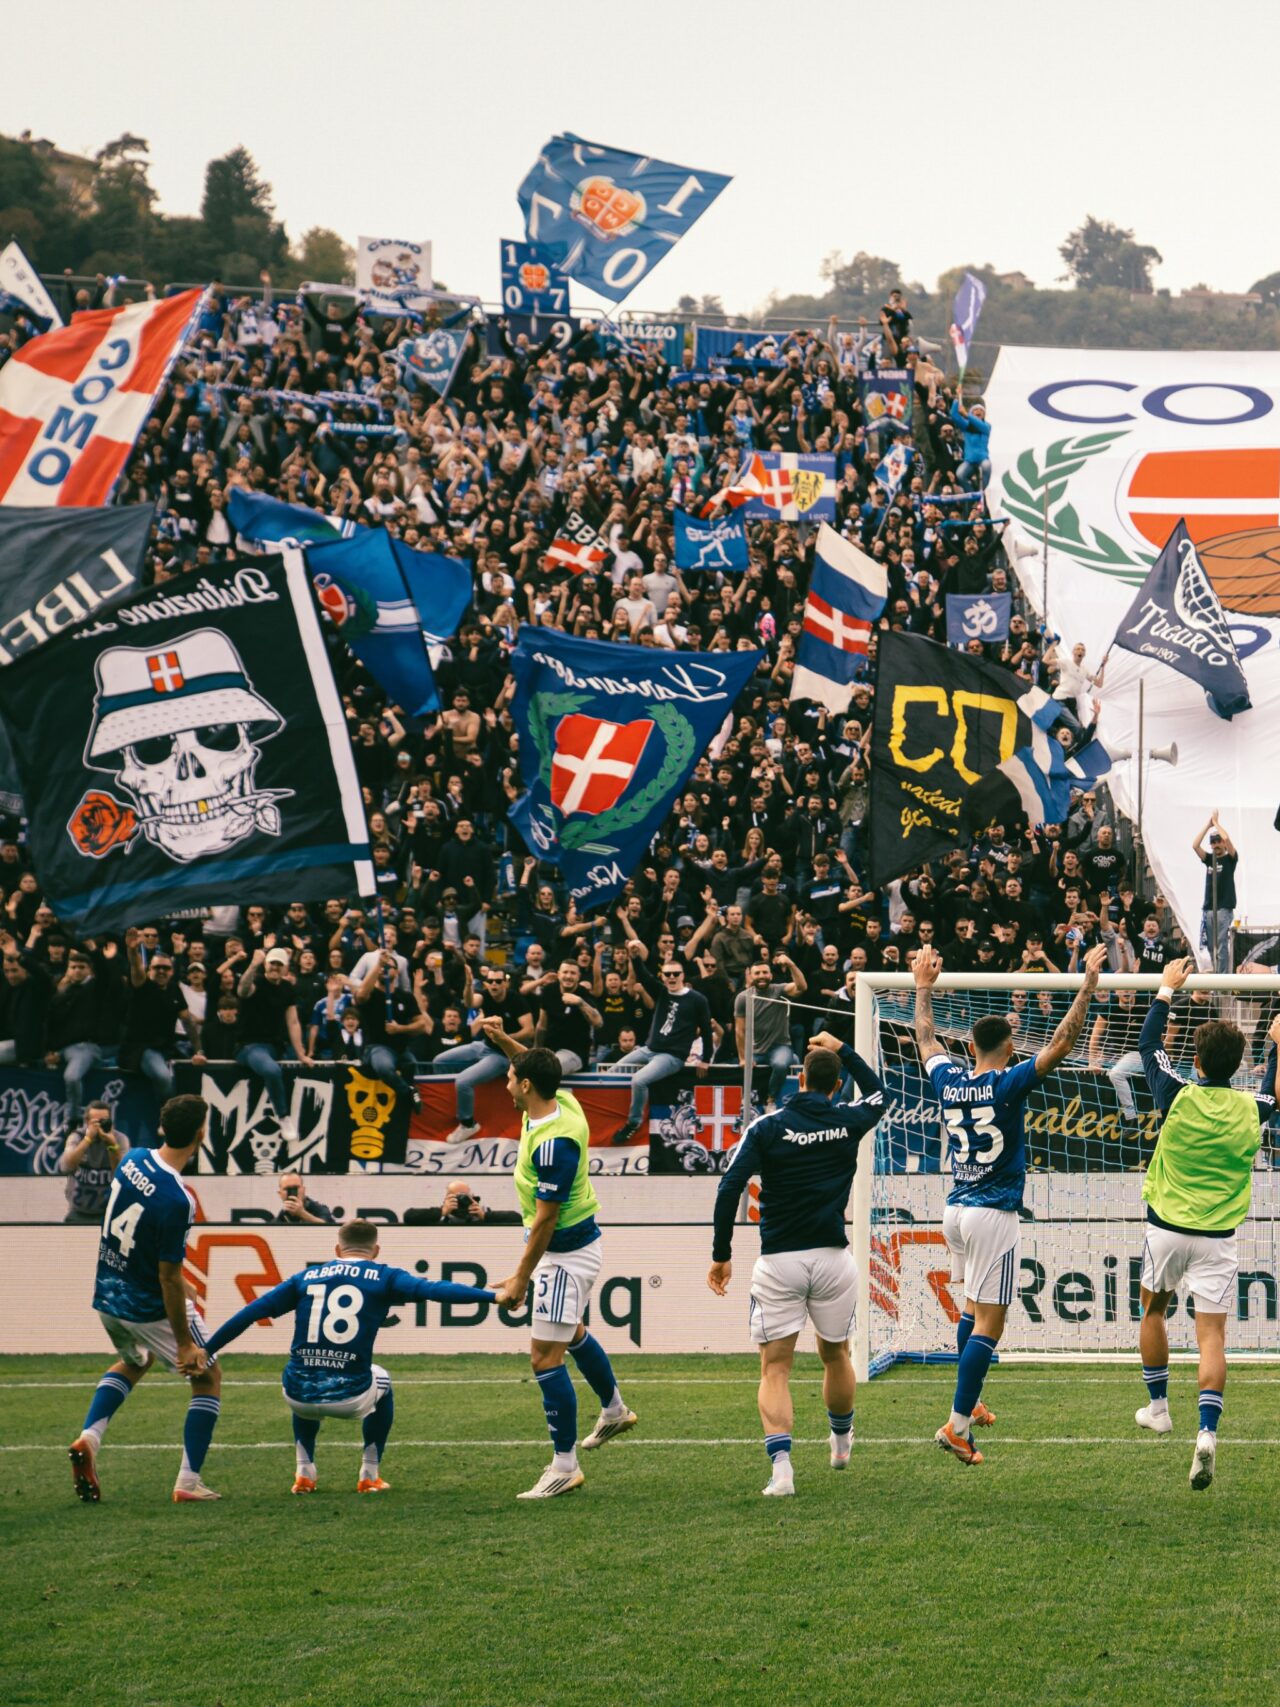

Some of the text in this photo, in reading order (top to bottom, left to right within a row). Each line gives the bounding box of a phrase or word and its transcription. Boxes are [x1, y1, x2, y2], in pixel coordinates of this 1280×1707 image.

[368, 239, 422, 254] COMO
[334, 422, 363, 432] FORZA
[1092, 855, 1116, 863] COMO
[943, 1085, 993, 1102] DACUNHA
[200, 1072, 334, 1163] MAD
[797, 1127, 848, 1145] OPTIMA
[944, 1106, 1004, 1163] 33
[405, 1150, 446, 1173] 25
[121, 1159, 156, 1197] JACOBO
[103, 1177, 145, 1258] 14
[303, 1264, 380, 1281] ALBERTO M.
[538, 1274, 549, 1298] 5
[306, 1284, 364, 1344] 18
[303, 1358, 345, 1369] BERMAN
